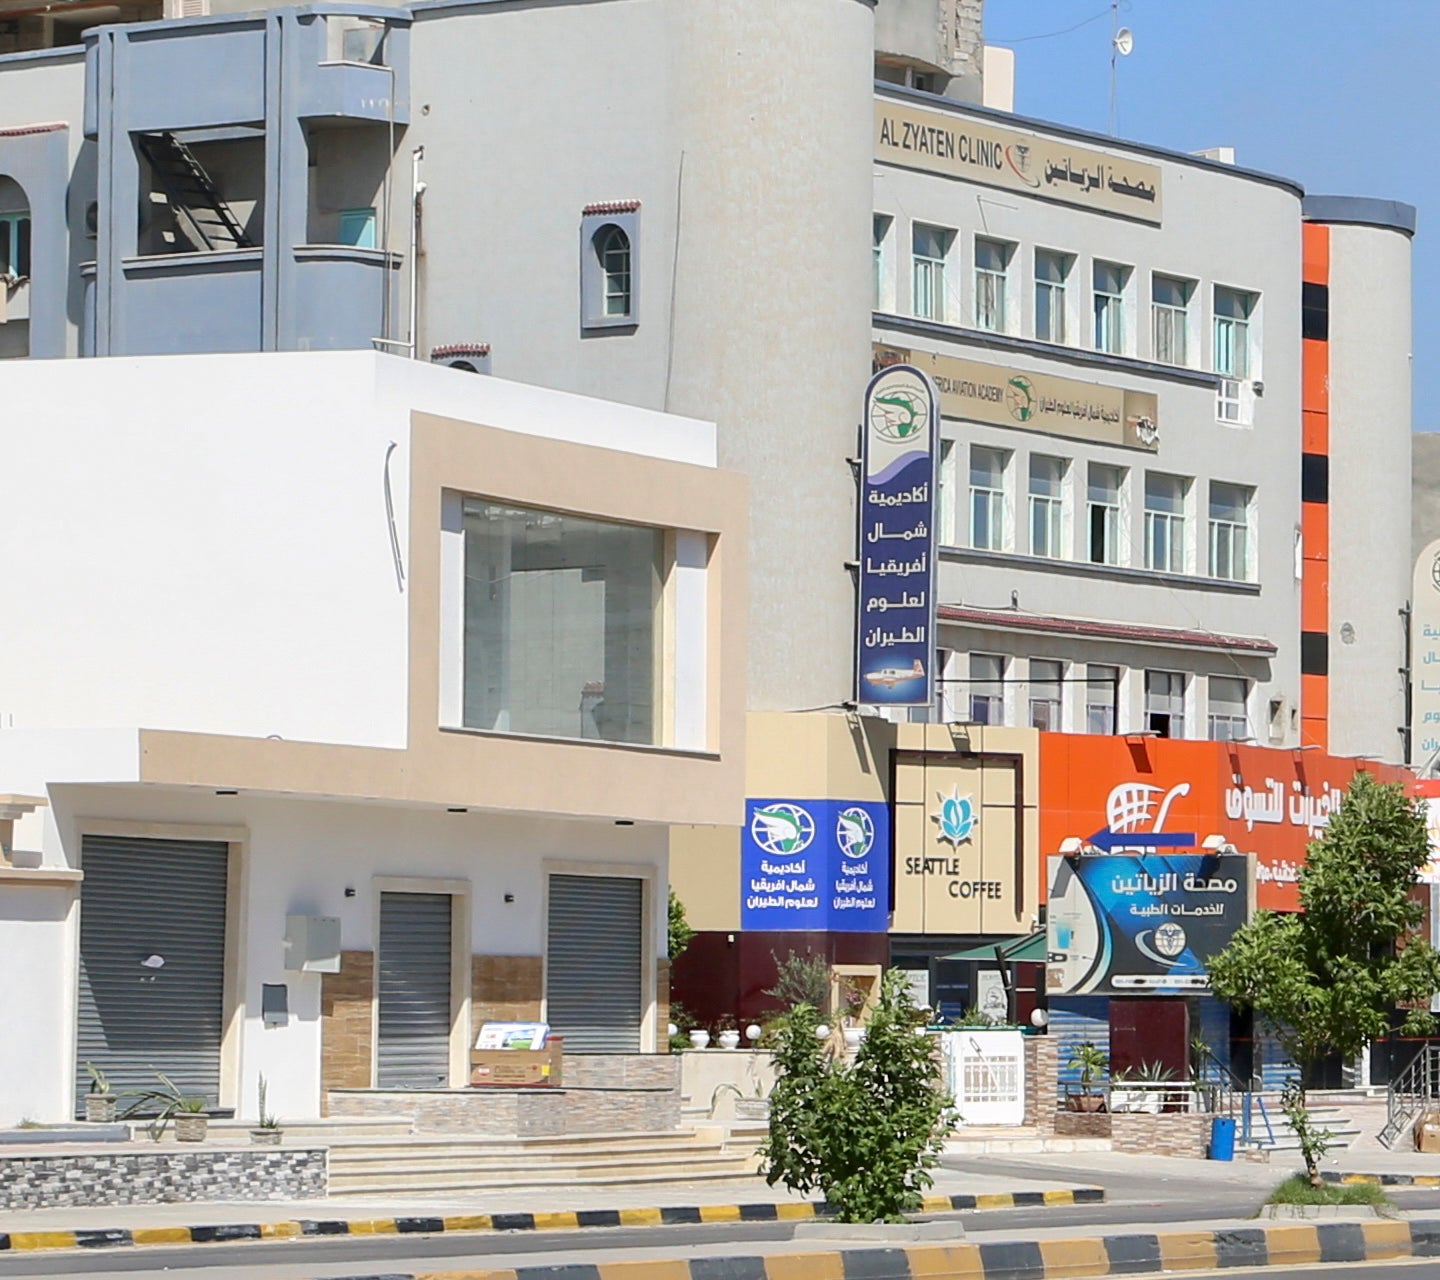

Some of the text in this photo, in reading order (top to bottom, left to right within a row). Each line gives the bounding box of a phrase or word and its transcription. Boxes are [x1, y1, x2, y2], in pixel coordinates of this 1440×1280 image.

[880, 118, 1003, 170] AL ZYATEN CLINIC
[1044, 157, 1156, 203] مصحة الزياتين
[868, 483, 928, 506] أكاديمية
[867, 521, 927, 543] شمال
[867, 552, 927, 576] أفريقيا
[866, 591, 925, 612] لعلوم
[865, 626, 925, 648] الطيران
[1225, 773, 1285, 832] للتسوق
[761, 860, 806, 875] أكاديمية
[905, 857, 960, 876] SEATTLE
[786, 878, 816, 893] شمال
[948, 880, 1002, 899] COFFEE
[1111, 872, 1177, 896] الزياتين
[1183, 872, 1238, 894] مصحة
[747, 895, 818, 909] لعلوم الطيران
[1130, 903, 1225, 917] للخدمات الطبية
